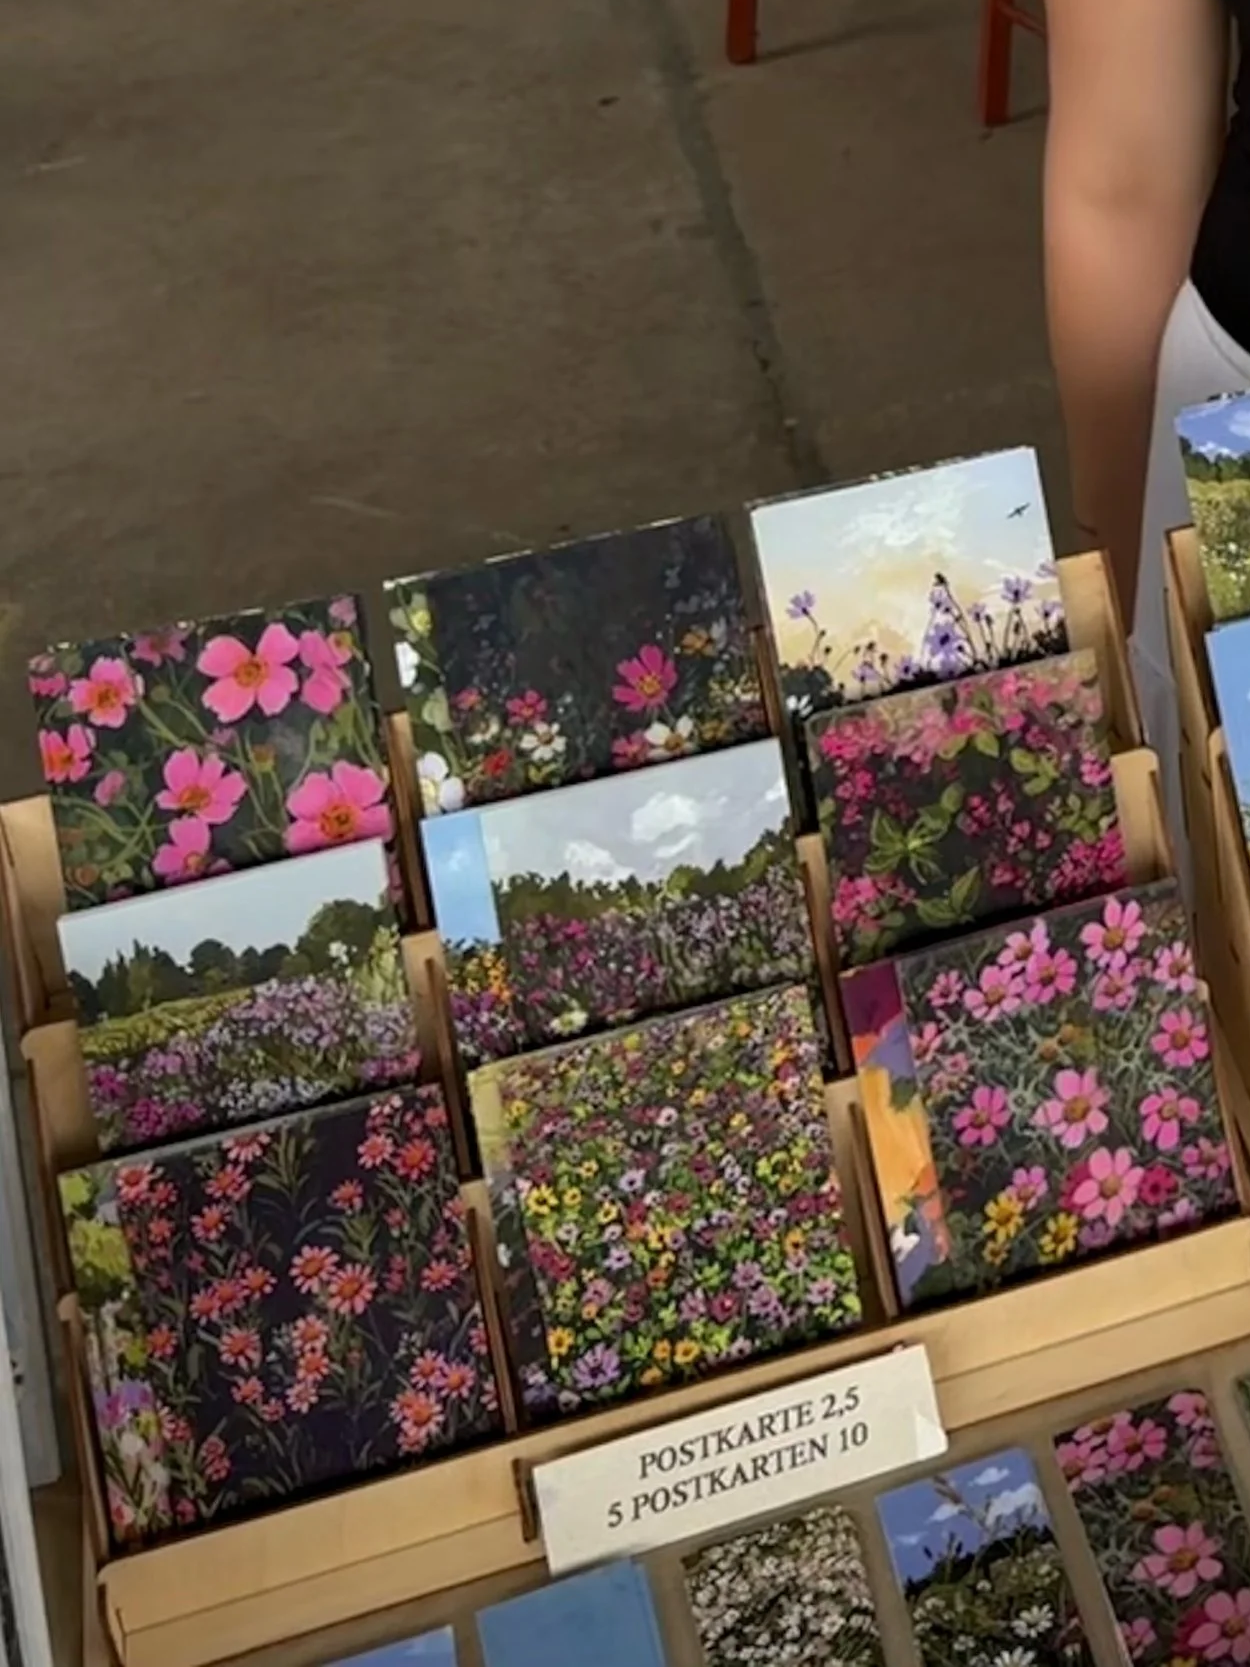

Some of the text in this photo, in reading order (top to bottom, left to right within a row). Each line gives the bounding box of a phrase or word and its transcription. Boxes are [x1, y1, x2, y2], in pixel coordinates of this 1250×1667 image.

[607, 1421, 869, 1528] 5 POSTKARTEN 10
[639, 1386, 861, 1479] POSTKARTE 2,5
